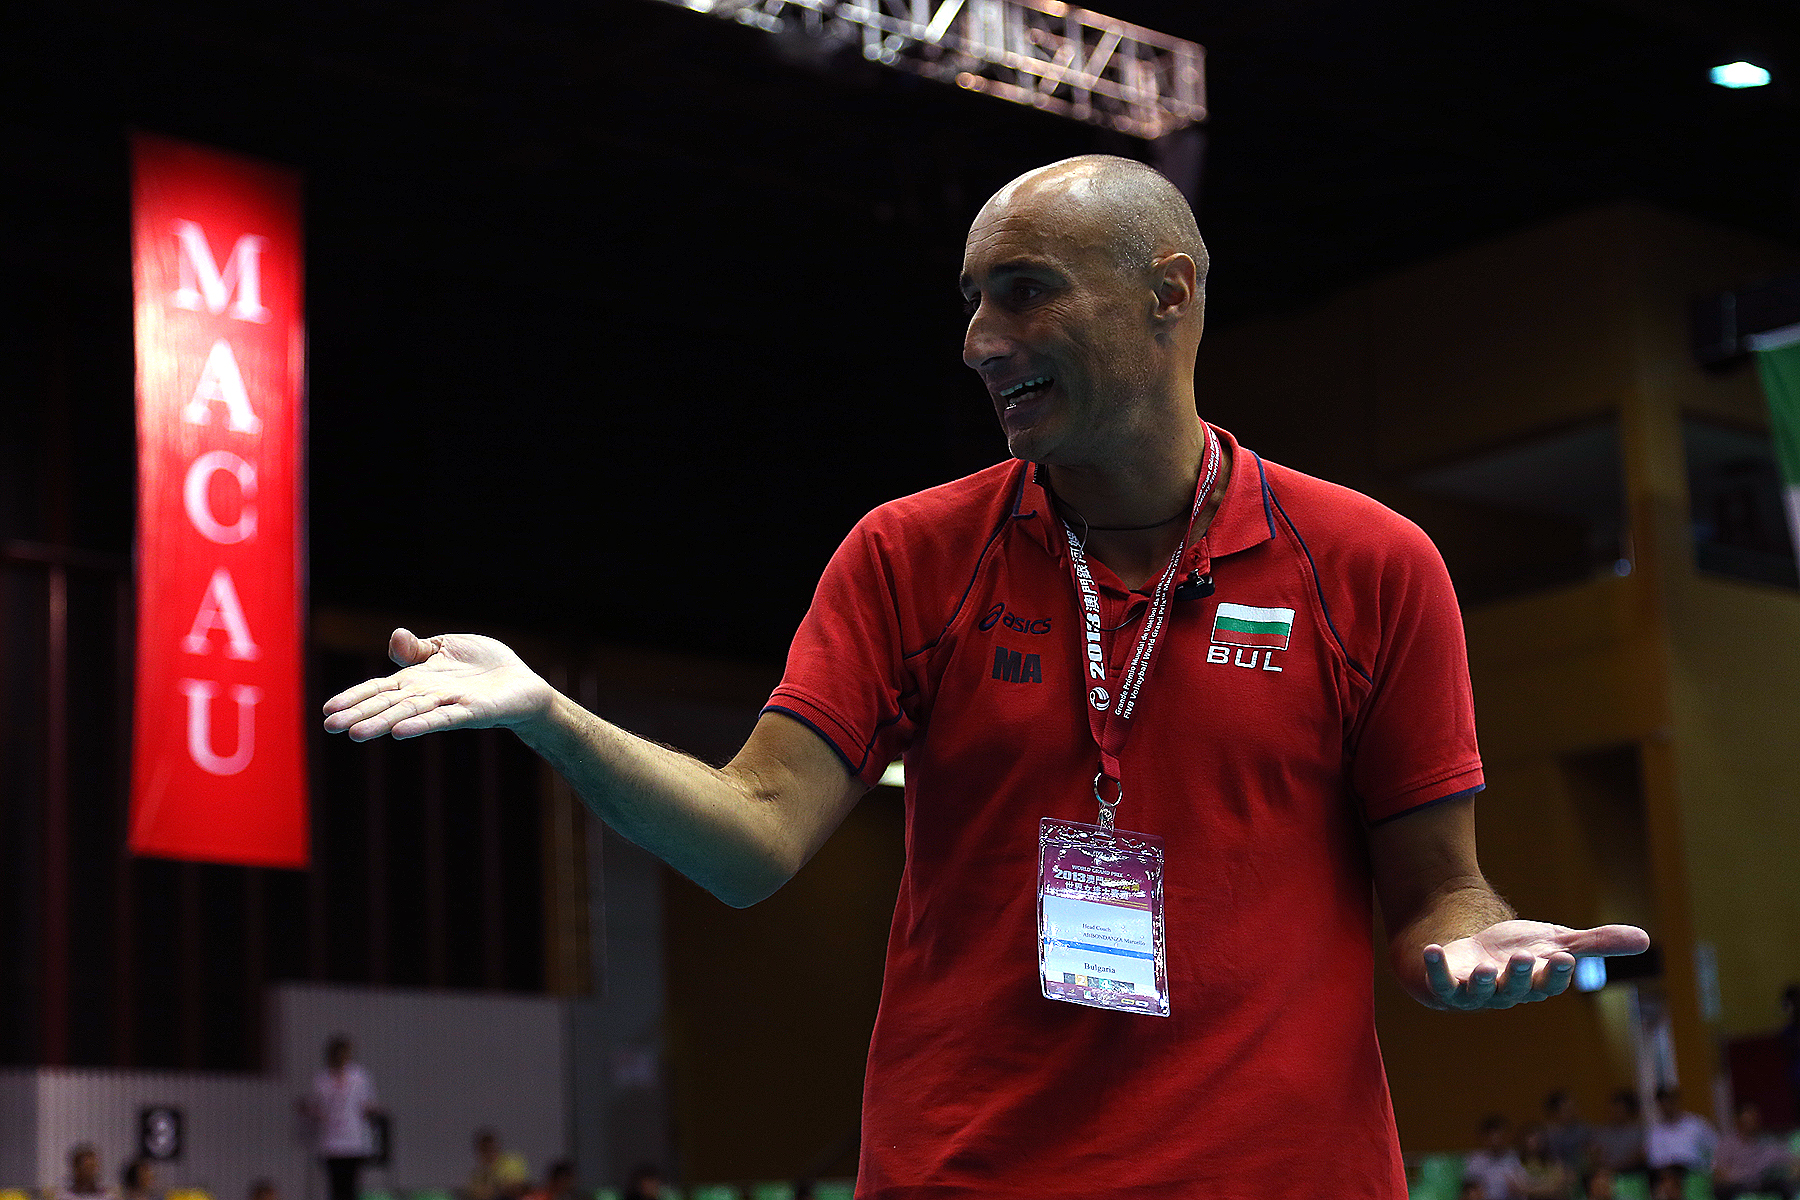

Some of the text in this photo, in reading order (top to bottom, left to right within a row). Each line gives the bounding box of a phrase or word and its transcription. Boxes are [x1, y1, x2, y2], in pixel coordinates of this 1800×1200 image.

[170, 217, 272, 776] MACAU
[1002, 612, 1052, 634] asics
[992, 646, 1042, 683] MA
[1123, 701, 1135, 719] FIVB
[1130, 661, 1149, 699] Volleyball
[1143, 638, 1156, 660] World
[1151, 616, 1163, 638] Grand
[1207, 645, 1282, 672] BUL
[1115, 691, 1128, 715] Grande
[1131, 641, 1145, 665] Mundial
[1084, 962, 1116, 975] Bulgaria
